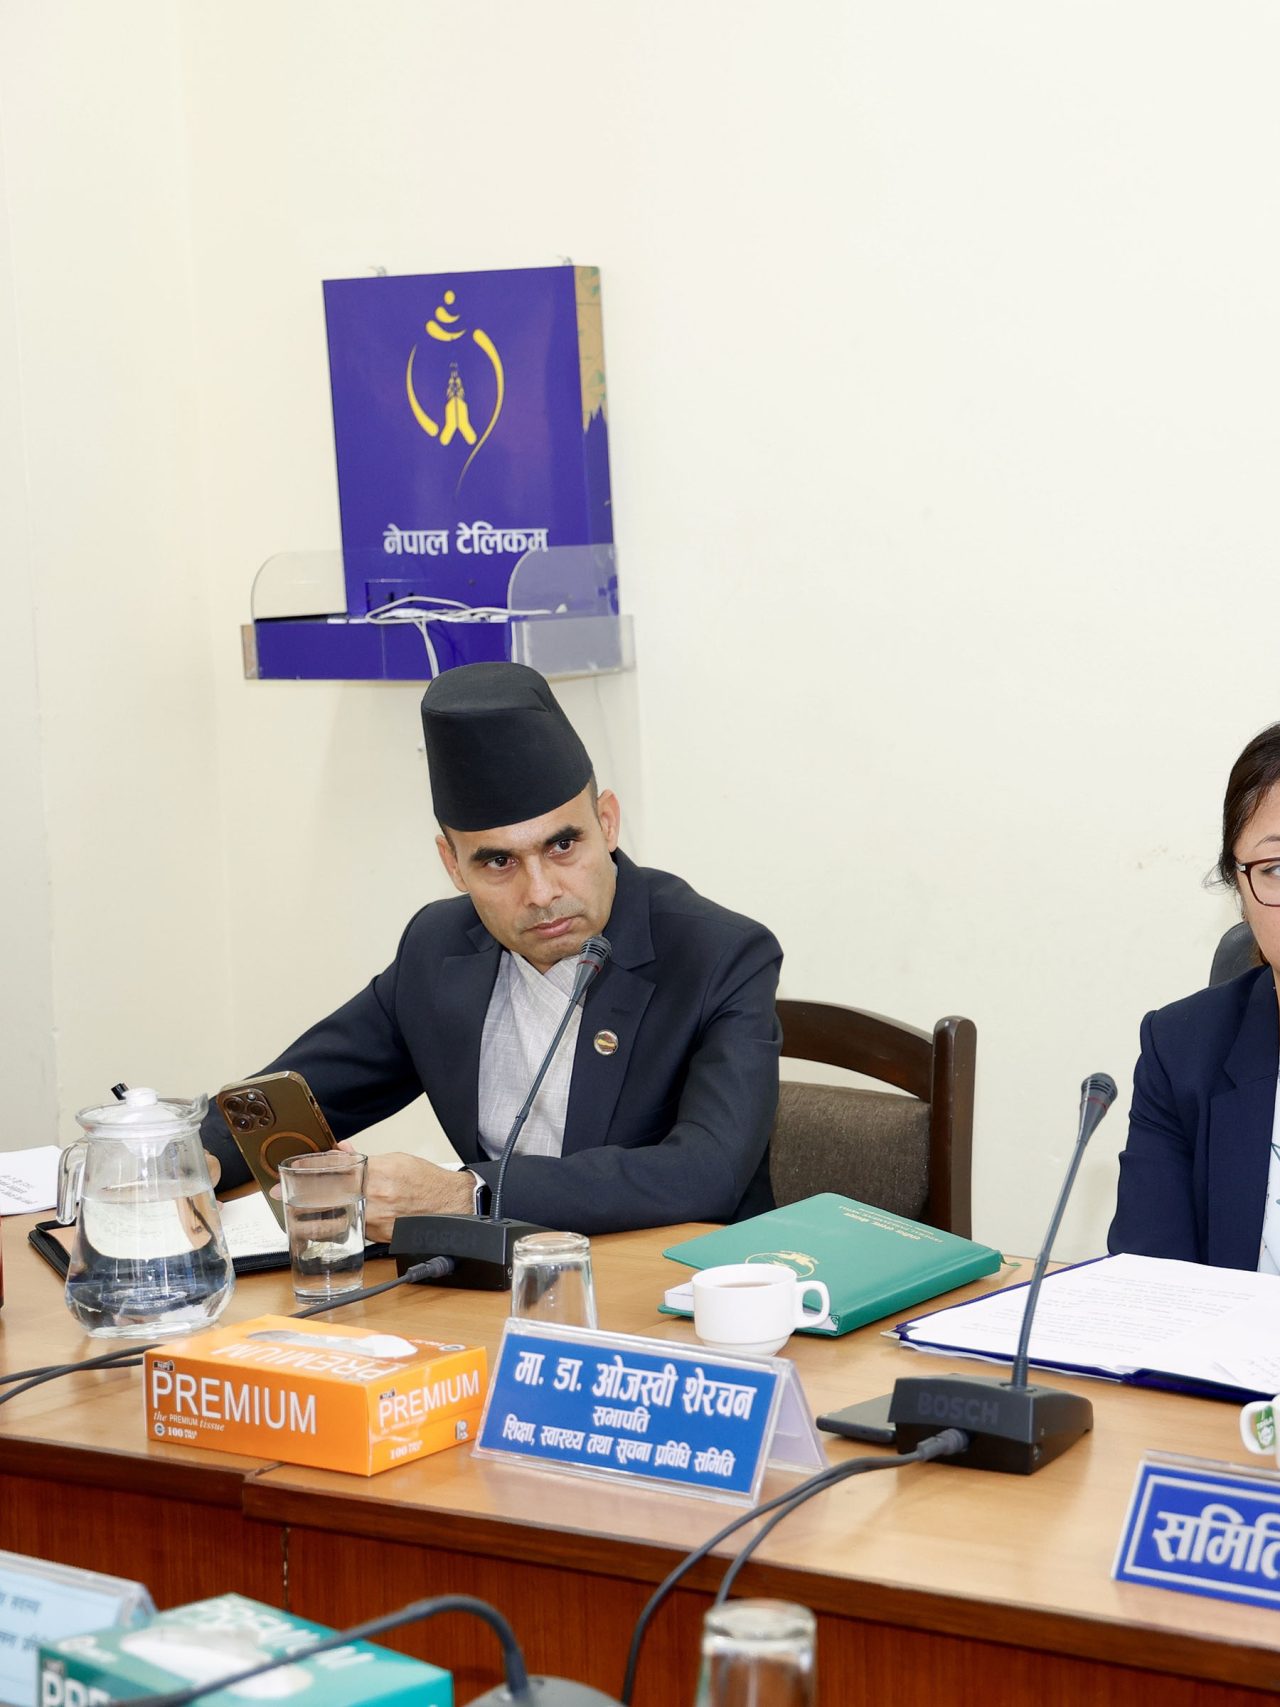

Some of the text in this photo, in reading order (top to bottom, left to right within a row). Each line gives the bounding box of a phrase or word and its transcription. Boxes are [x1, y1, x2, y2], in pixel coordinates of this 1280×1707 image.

[382, 520, 548, 556] नेपाल टेलिकम
[152, 1369, 317, 1435] PREMIUM
[378, 1369, 480, 1429] PREMIUM
[514, 1351, 757, 1420] मा. डा. ओजस्वी शेरचन
[153, 1411, 225, 1432] the PREMIUM tissue
[592, 1405, 651, 1433] सभापति
[917, 1391, 1000, 1427] BOSCH
[168, 1426, 184, 1438] 100
[502, 1413, 536, 1446] शिक्षा,
[587, 1433, 614, 1456] तथा
[616, 1437, 653, 1465] सूचना
[654, 1440, 692, 1469] प्रविधि
[694, 1446, 736, 1477] समिति
